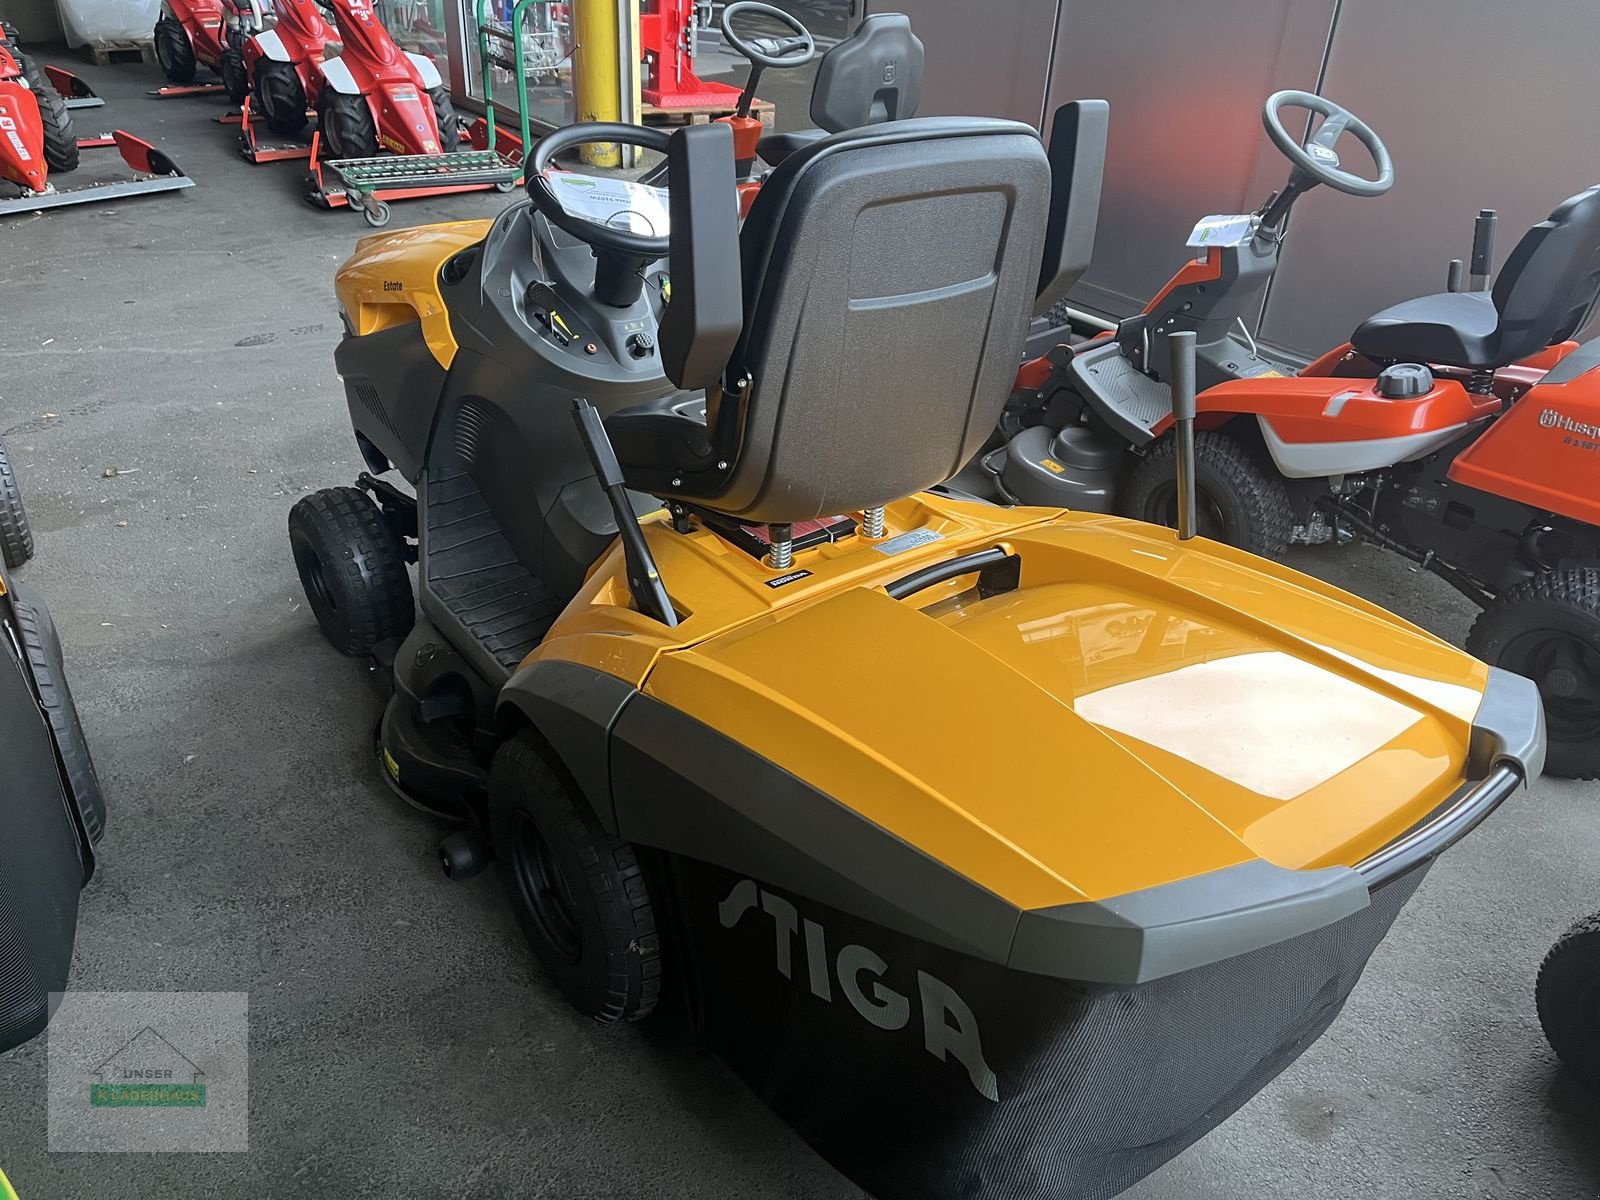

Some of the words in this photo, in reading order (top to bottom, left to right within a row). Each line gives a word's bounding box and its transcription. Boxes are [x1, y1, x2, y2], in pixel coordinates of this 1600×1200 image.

[384, 280, 403, 291] Estate
[1557, 415, 1600, 439] Husq
[718, 879, 999, 1103] STIGA
